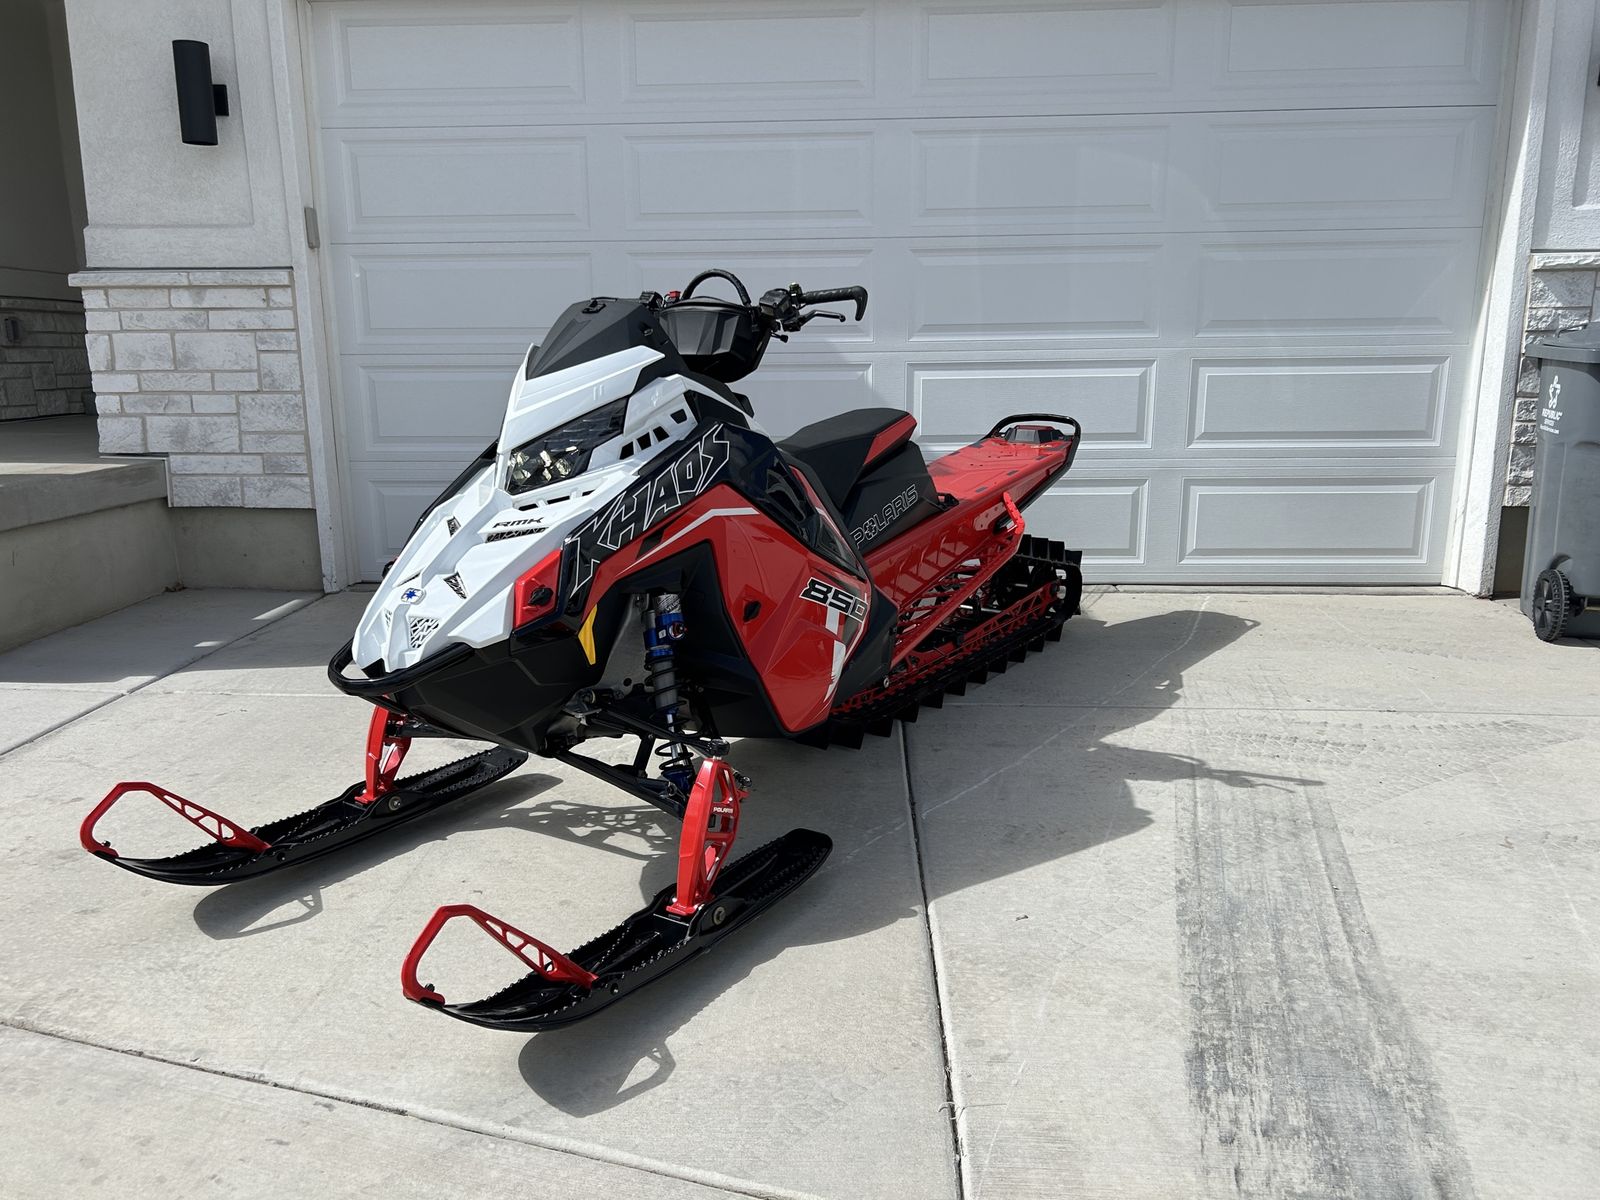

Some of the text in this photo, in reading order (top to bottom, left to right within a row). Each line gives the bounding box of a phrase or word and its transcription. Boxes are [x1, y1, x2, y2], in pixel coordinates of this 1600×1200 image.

[492, 516, 545, 529] RMK
[570, 422, 730, 599] KHAOS
[849, 483, 919, 550] POLARIS
[798, 576, 869, 624] 850
